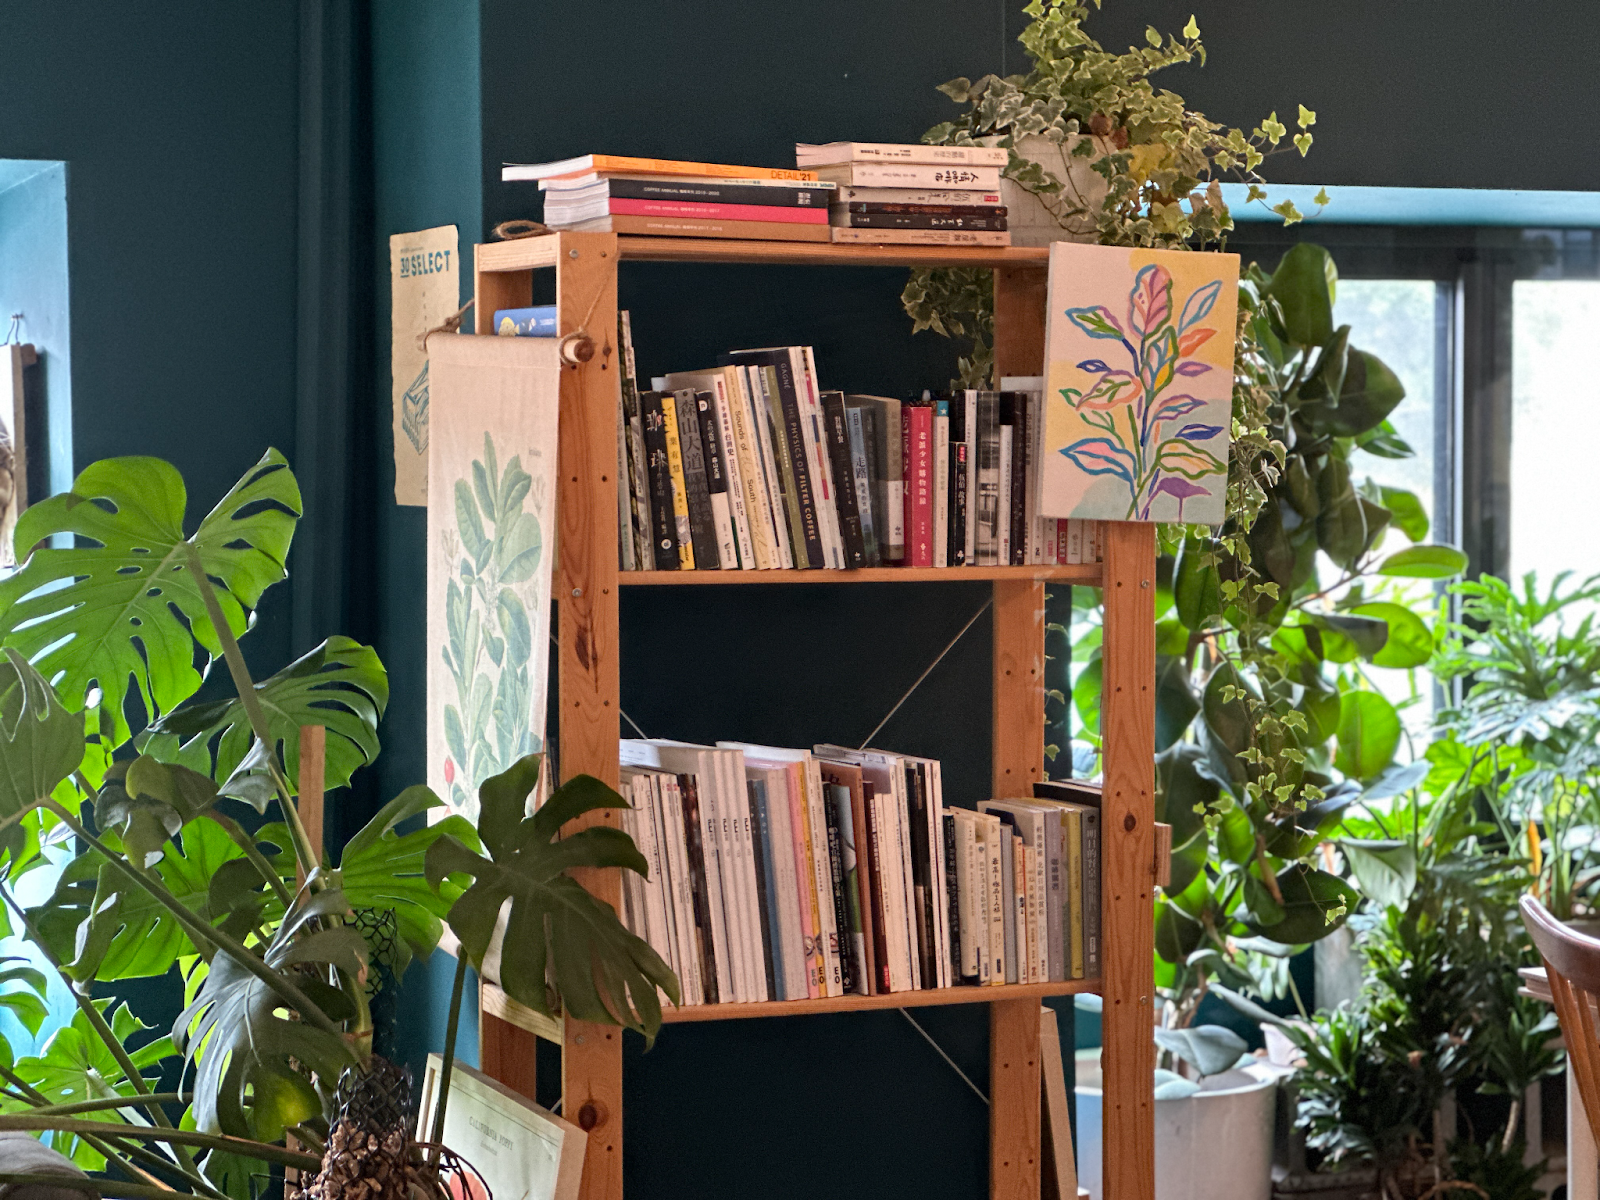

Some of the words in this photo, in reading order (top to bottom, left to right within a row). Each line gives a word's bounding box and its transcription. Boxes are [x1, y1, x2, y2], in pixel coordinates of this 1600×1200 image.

[411, 249, 451, 277] SELECT
[787, 403, 797, 420] THE
[680, 400, 704, 470] 森山大道
[790, 422, 803, 459] PHYSICS
[796, 461, 805, 472] OF
[855, 456, 867, 479] 走路
[746, 478, 757, 502] South
[799, 474, 810, 505] FILTER
[804, 507, 816, 541] COFFEE
